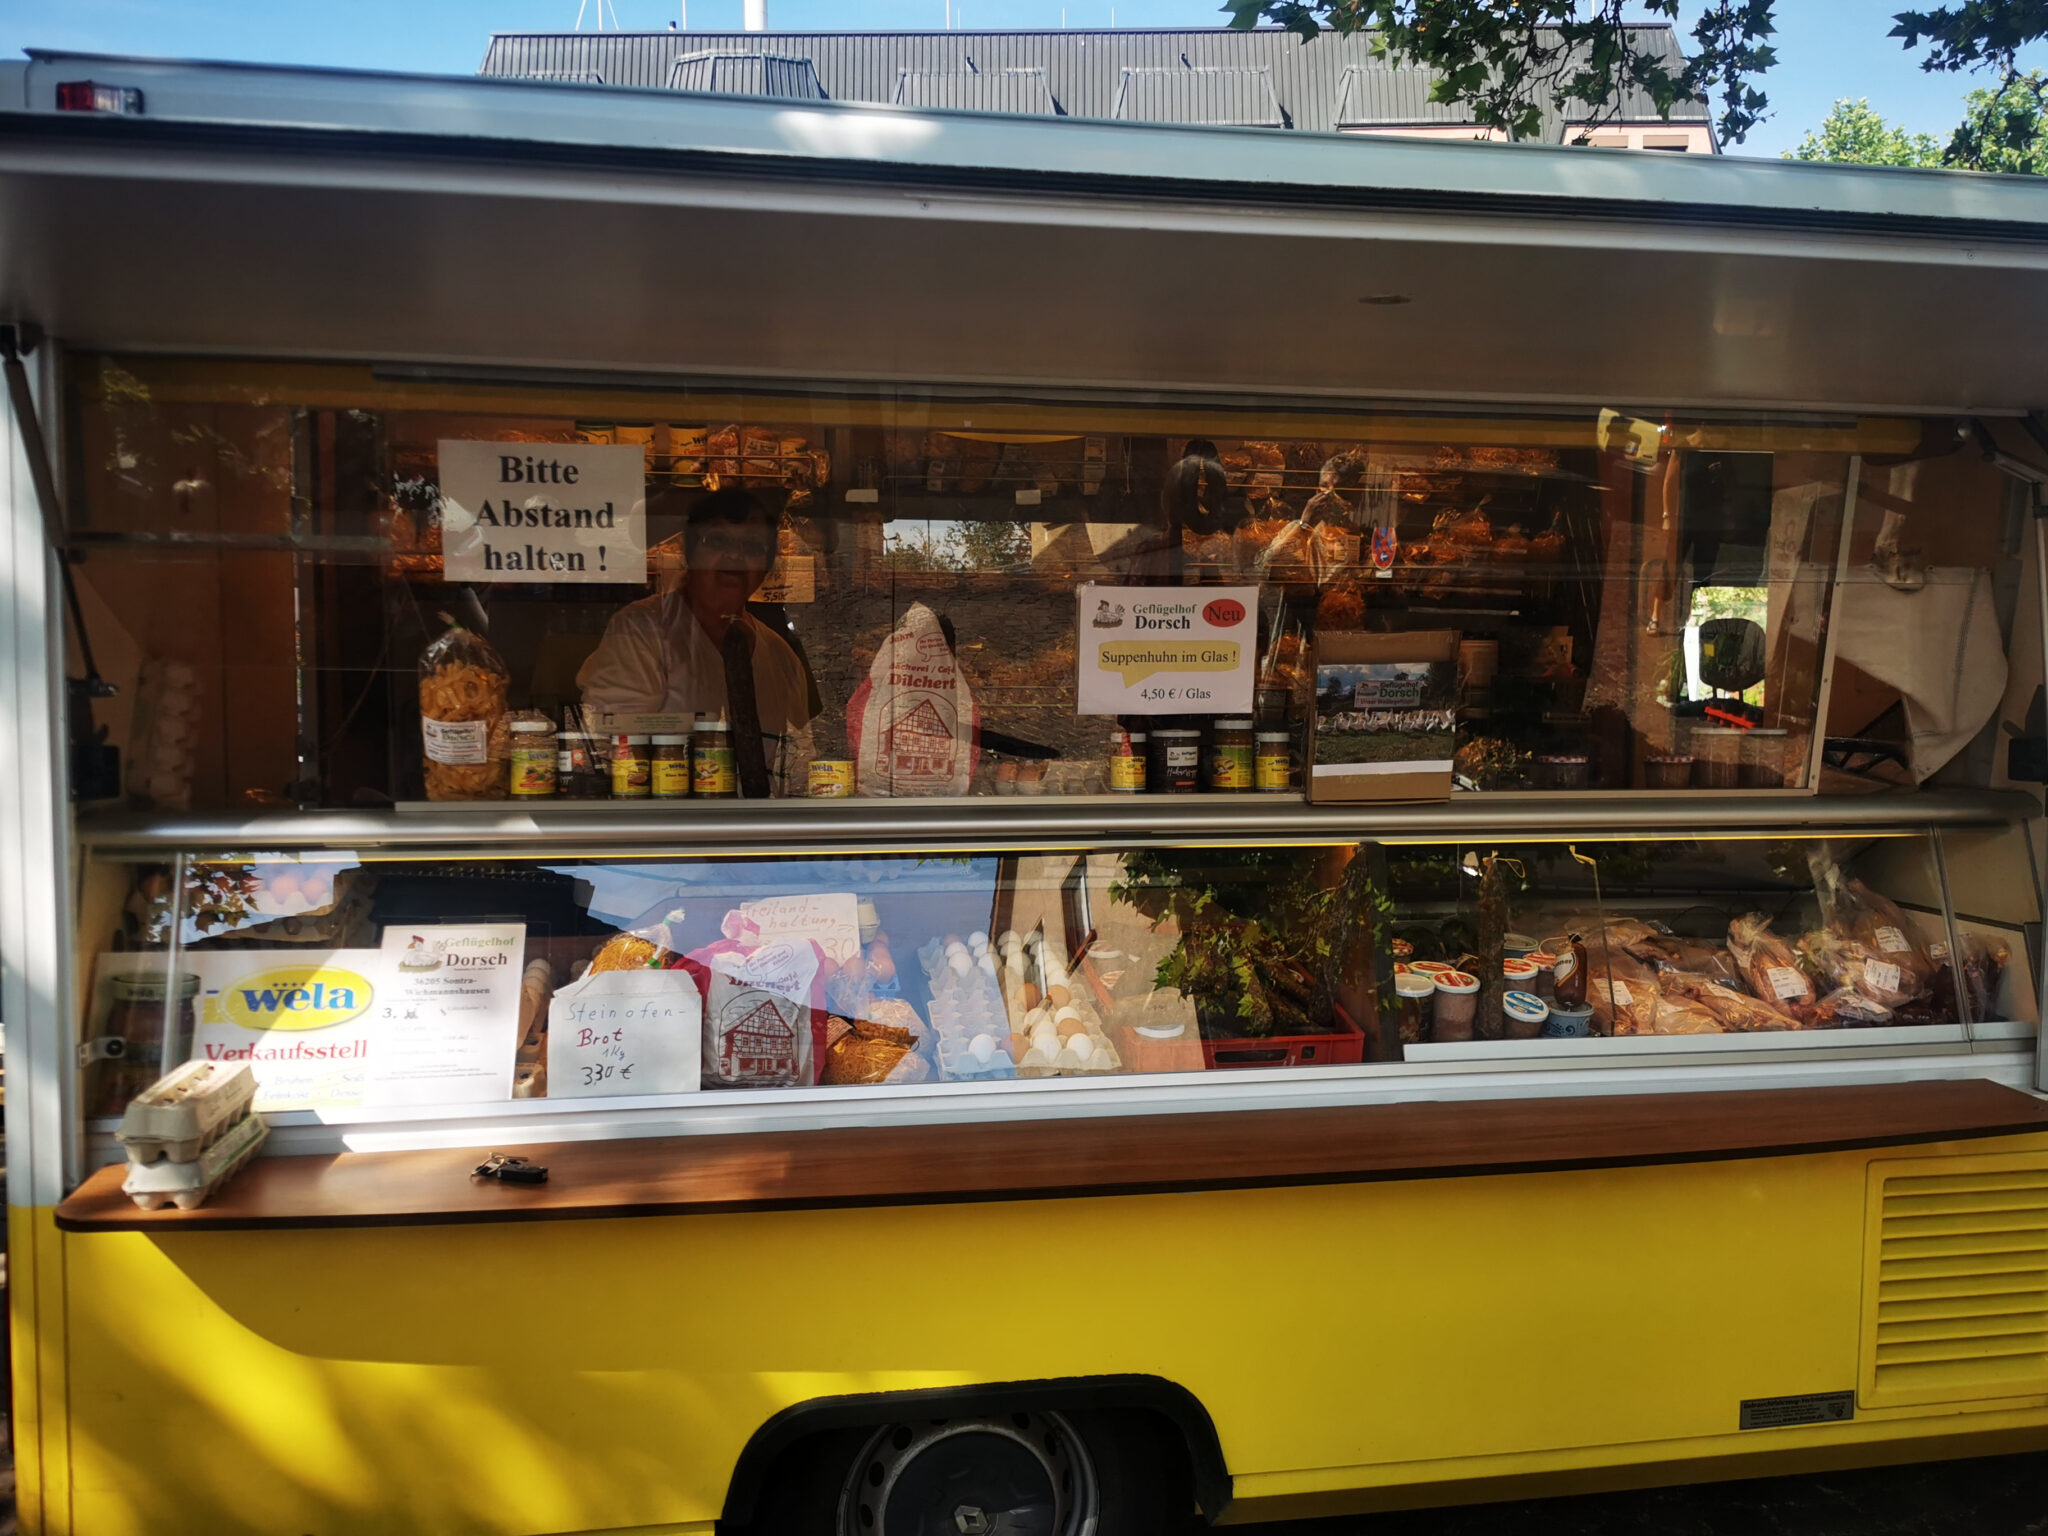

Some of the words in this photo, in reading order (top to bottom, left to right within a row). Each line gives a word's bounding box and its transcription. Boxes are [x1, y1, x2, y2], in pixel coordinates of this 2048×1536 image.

[498, 455, 580, 485] Bitte
[473, 499, 616, 529] Abstand
[483, 544, 586, 571] halten
[598, 545, 607, 572] !
[1132, 603, 1198, 616] Geflügelhof
[1207, 606, 1241, 622] Neu
[1134, 615, 1191, 630] Dorsch
[1101, 650, 1178, 666] Suppenhuhn
[1181, 650, 1197, 663] im
[1201, 650, 1229, 662] Glas
[1232, 650, 1237, 663] !
[887, 673, 957, 690] Dilchert
[1140, 688, 1165, 701] 4,50
[1168, 688, 1177, 700] €
[1178, 688, 1184, 700] /
[1185, 687, 1212, 699] Glas
[1379, 687, 1420, 698] Dorsch
[811, 763, 835, 773] wela
[768, 914, 837, 929] haltung
[445, 936, 516, 948] Geflügelhof
[446, 952, 508, 967] Dorsch
[240, 982, 359, 1013] wela
[576, 1027, 623, 1048] Brot
[620, 1063, 636, 1080] €
